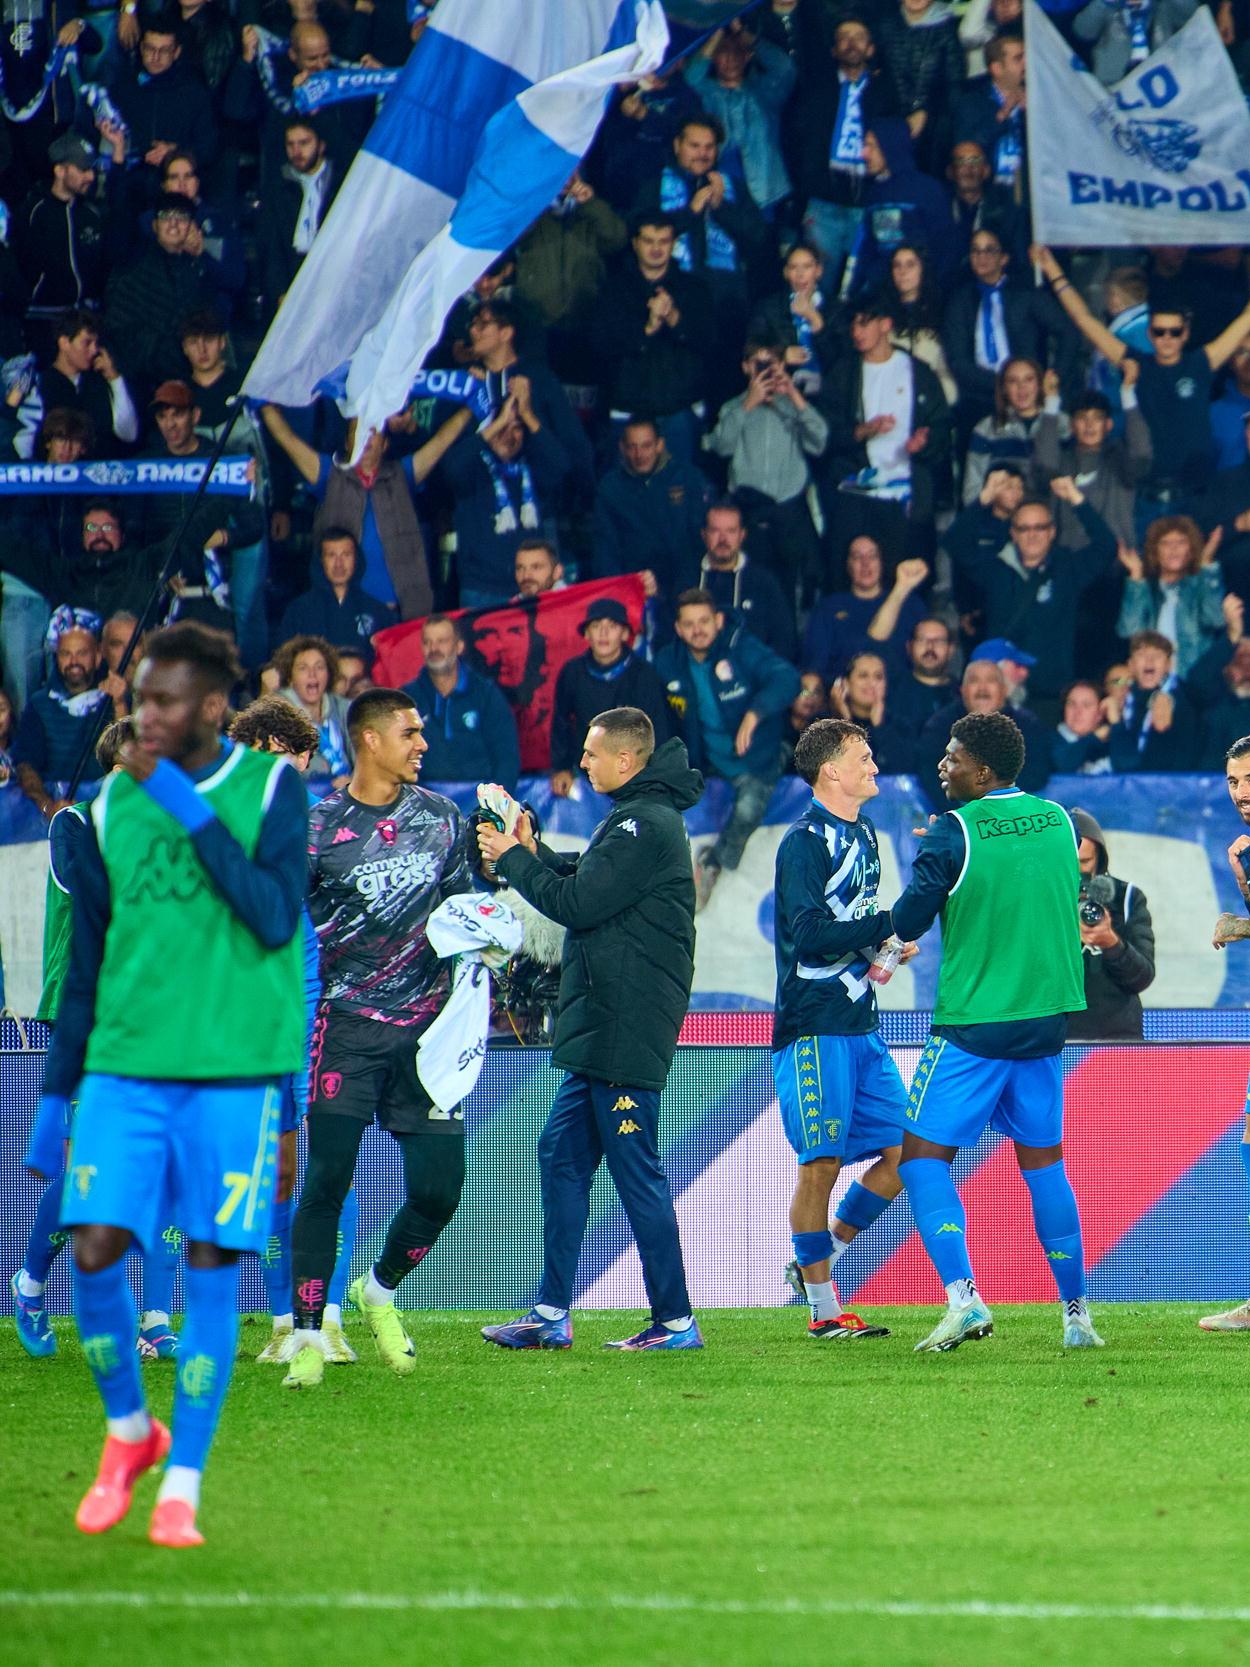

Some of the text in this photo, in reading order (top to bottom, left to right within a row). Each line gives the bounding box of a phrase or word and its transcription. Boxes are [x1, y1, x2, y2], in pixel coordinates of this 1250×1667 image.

[136, 461, 250, 486] AMORE
[976, 811, 1062, 840] Kappa
[353, 850, 434, 877] computer
[355, 861, 437, 901] gross
[214, 1171, 249, 1227] 7
